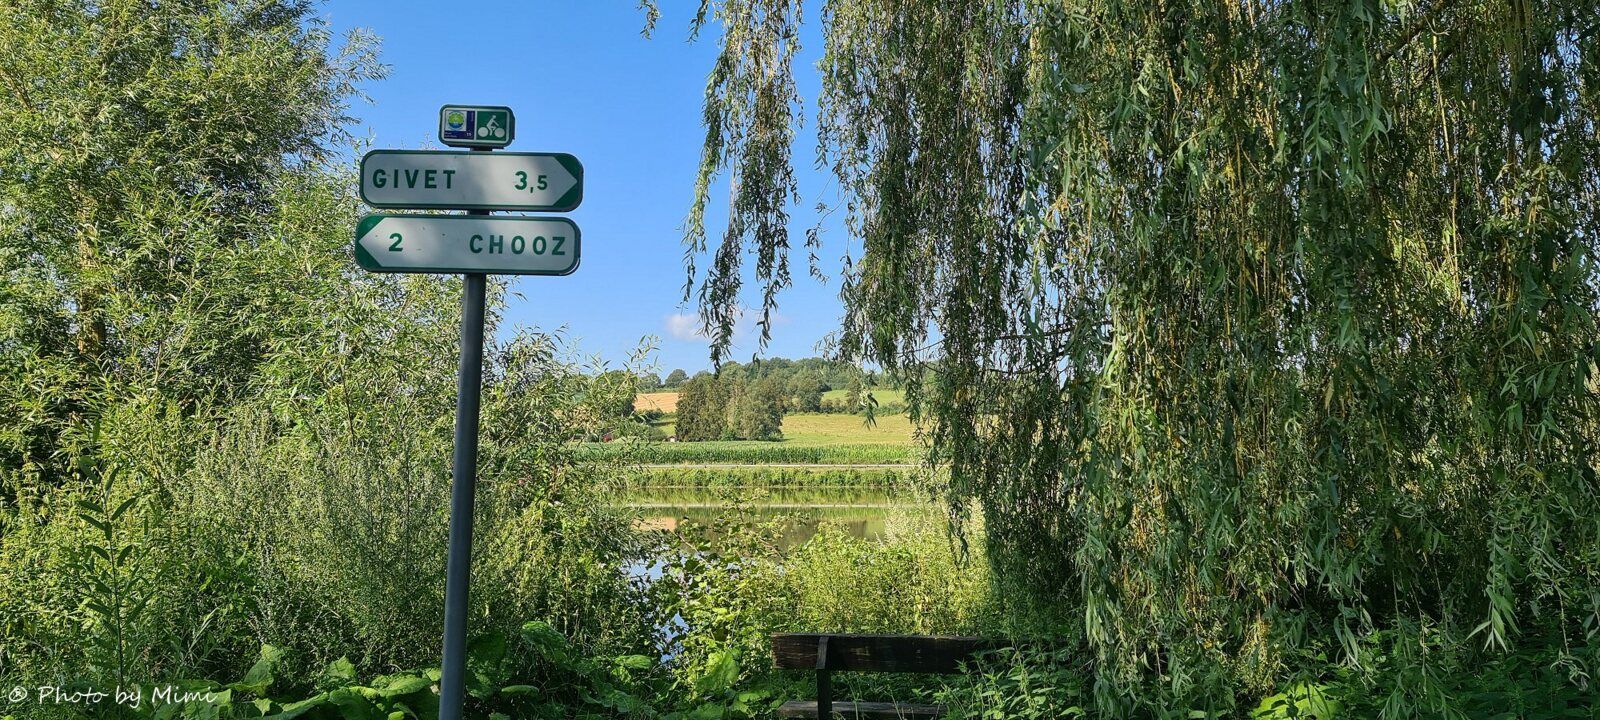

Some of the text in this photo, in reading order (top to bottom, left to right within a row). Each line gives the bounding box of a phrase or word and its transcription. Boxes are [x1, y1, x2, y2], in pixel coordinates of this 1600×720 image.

[372, 168, 548, 194] GIVET 3,5
[388, 232, 566, 256] 2 CHOOZ
